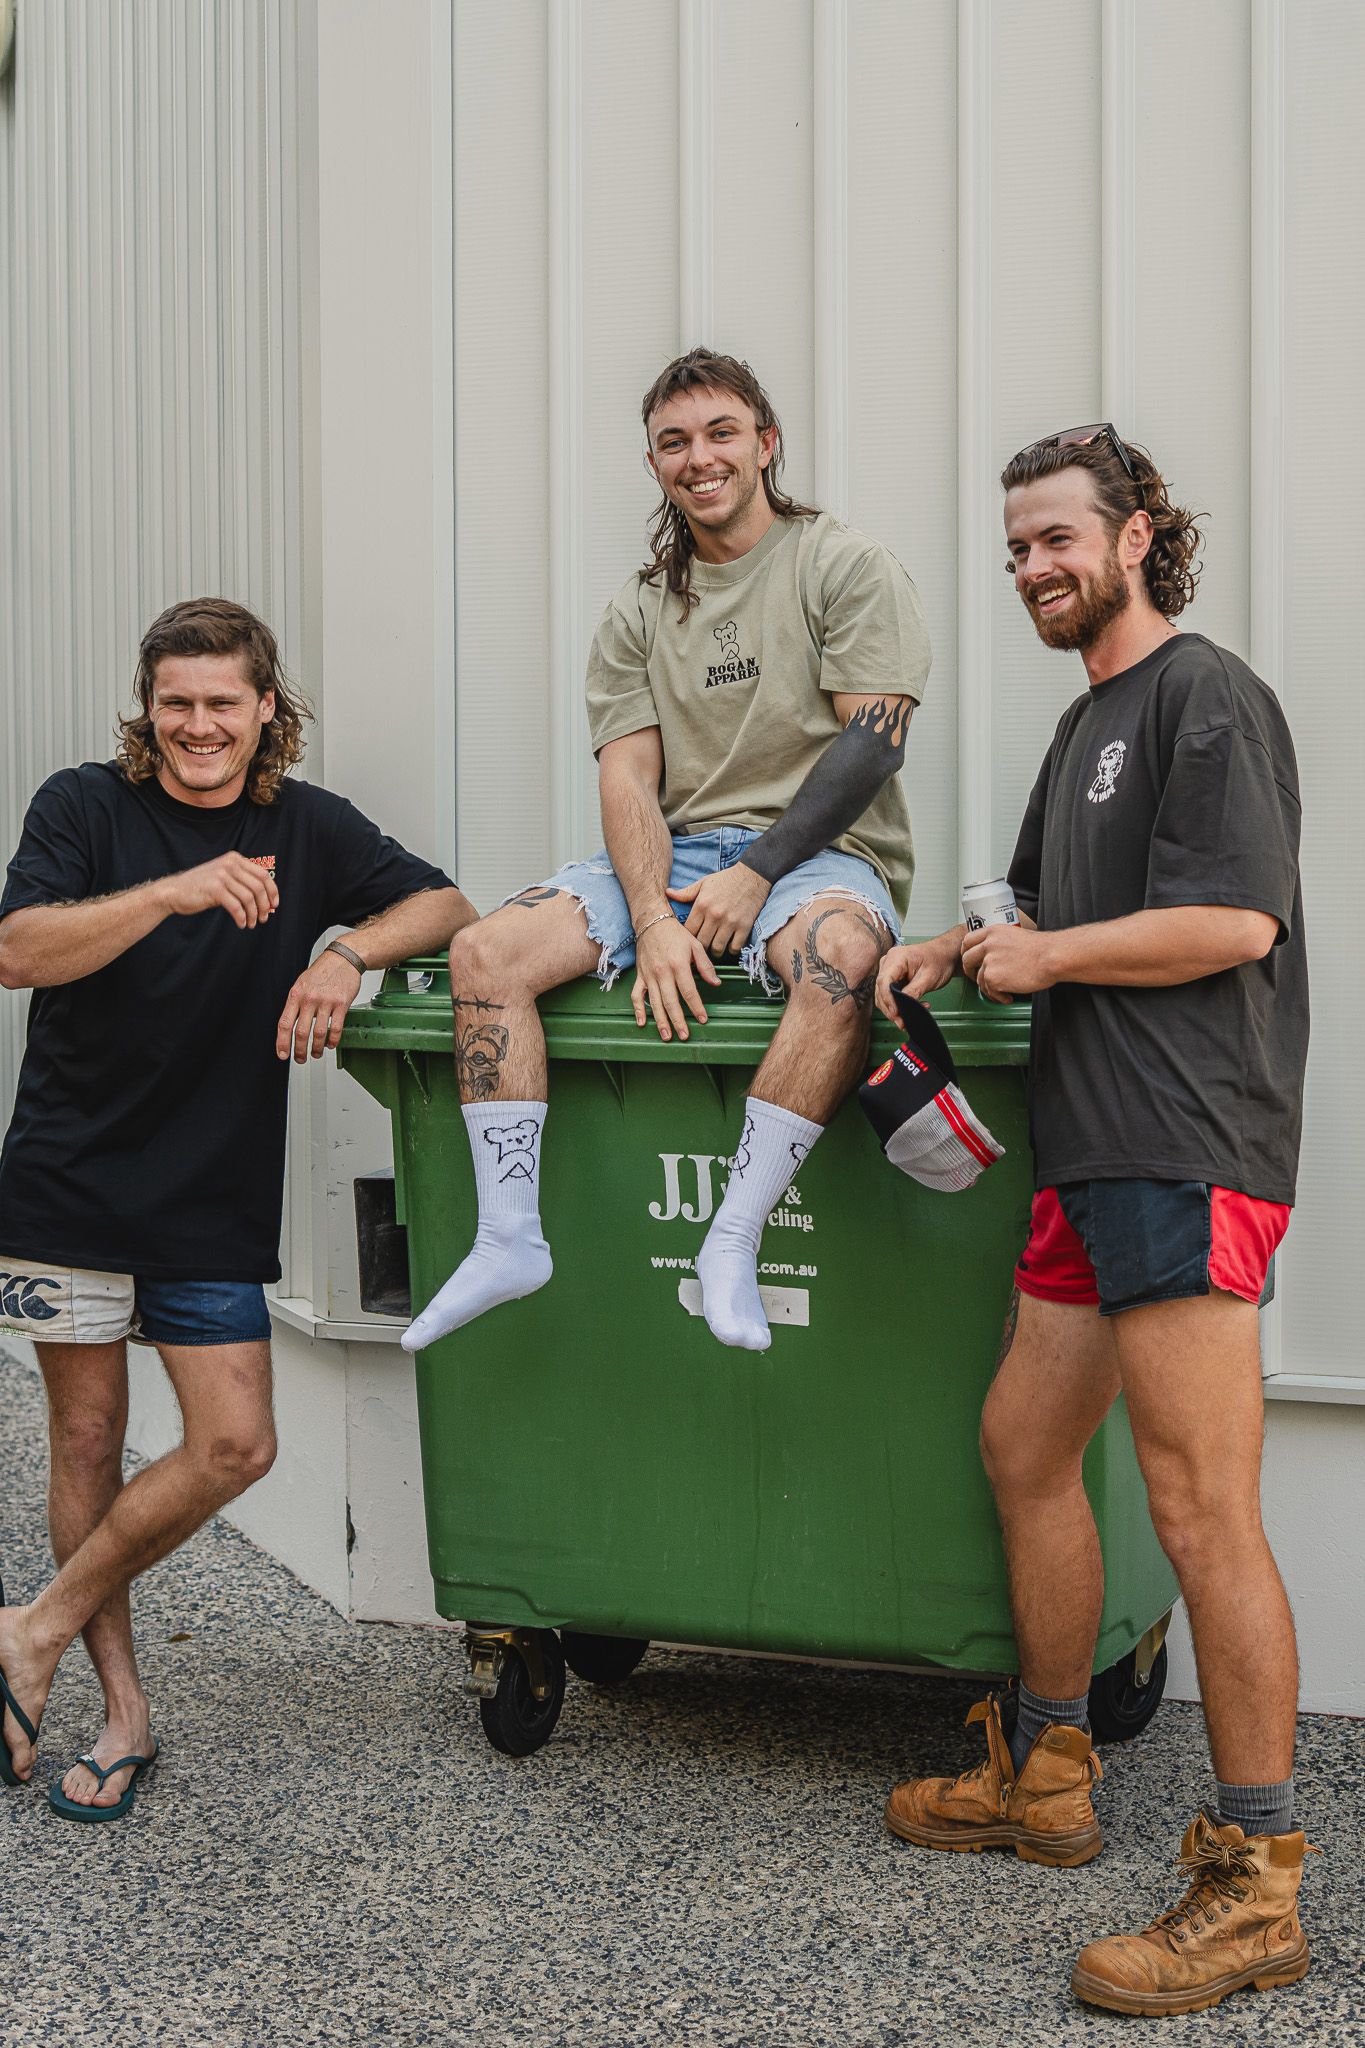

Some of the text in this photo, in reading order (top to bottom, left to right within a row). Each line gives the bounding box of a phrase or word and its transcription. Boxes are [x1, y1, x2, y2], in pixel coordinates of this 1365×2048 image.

[706, 656, 756, 677] BOGAN
[784, 1185, 802, 1205] &
[767, 1207, 814, 1233] cling
